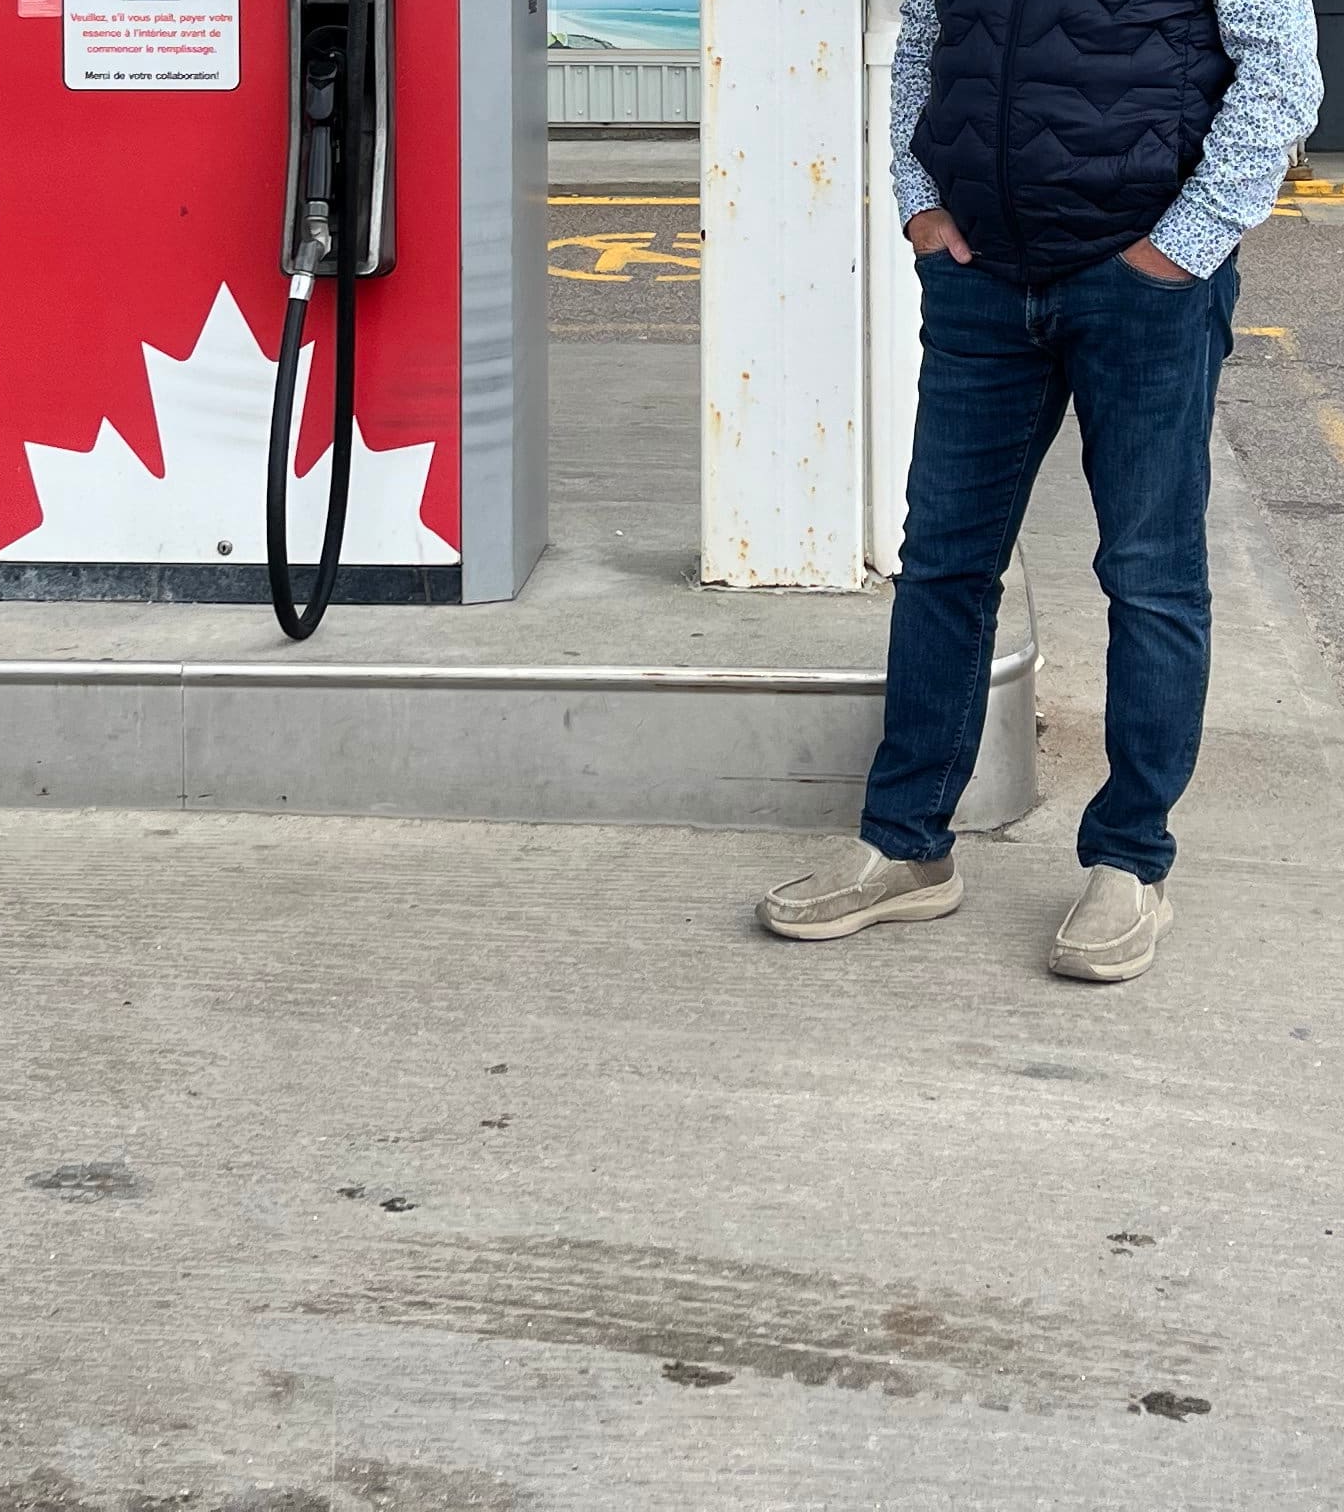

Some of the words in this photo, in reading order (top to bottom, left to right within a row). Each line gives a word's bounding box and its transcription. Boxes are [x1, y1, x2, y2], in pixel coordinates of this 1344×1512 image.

[111, 13, 125, 22] s'il
[127, 14, 151, 22] vous
[179, 14, 207, 25] payer
[209, 14, 233, 22] votre
[82, 30, 122, 38] essence
[124, 28, 131, 38] à
[134, 28, 178, 38] l'intérieur
[181, 29, 206, 38] avant
[209, 29, 221, 38] de
[87, 45, 142, 53] commencer
[146, 44, 154, 53] le
[157, 44, 217, 56] remplissage.
[85, 71, 111, 80] Merci
[113, 71, 126, 80] de
[129, 72, 153, 80] votre
[155, 71, 220, 80] collaboration!
